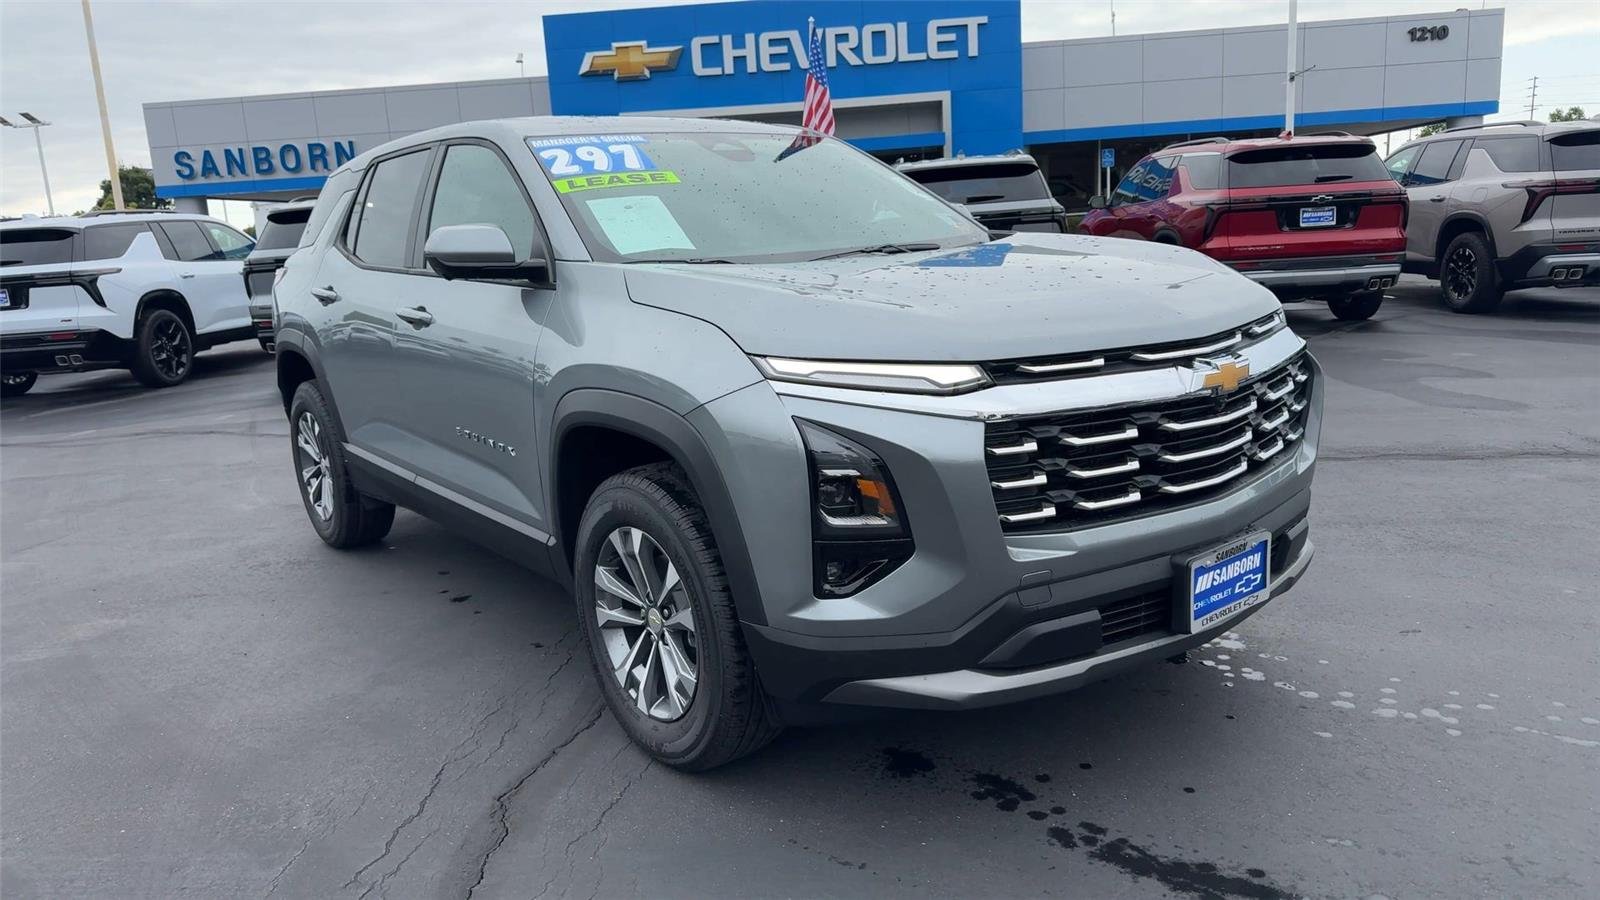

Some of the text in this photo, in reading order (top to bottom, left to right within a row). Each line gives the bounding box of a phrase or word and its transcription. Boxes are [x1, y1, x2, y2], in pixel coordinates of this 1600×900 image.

[1407, 25, 1450, 42] 1210
[691, 15, 989, 77] CHEVROLET
[532, 135, 645, 147] MANAGER'S SPECIAL
[174, 140, 356, 180] SANBORN
[540, 144, 645, 174] 297
[568, 173, 667, 190] LEASE
[1215, 542, 1248, 563] SANBORN
[1213, 552, 1261, 586] SANBORN
[1194, 588, 1232, 610] CHEVROLET
[1201, 602, 1242, 626] CHEVROLET
